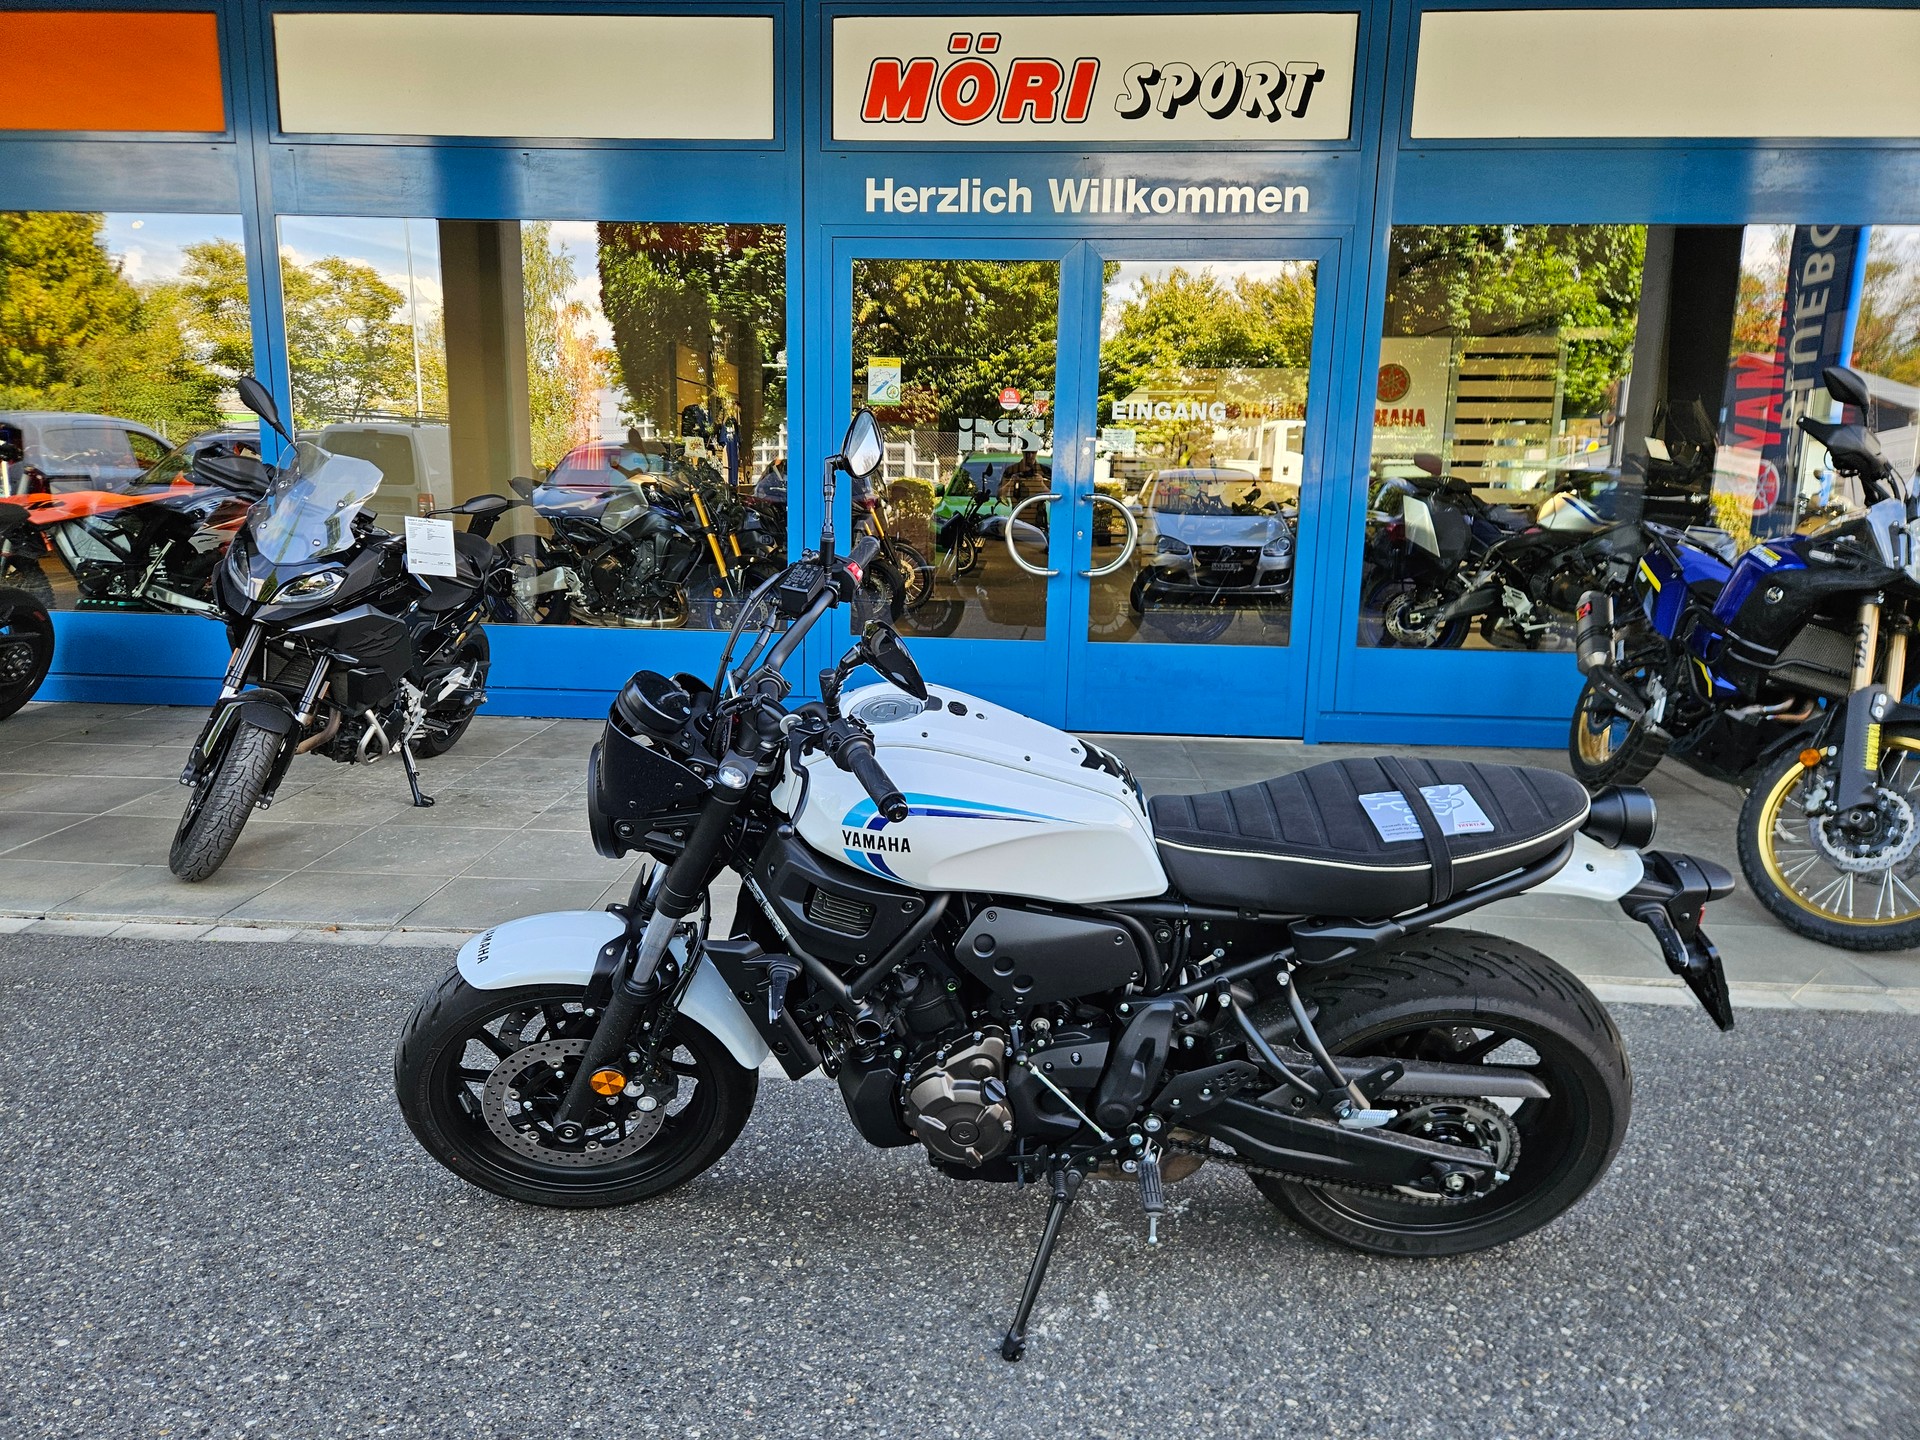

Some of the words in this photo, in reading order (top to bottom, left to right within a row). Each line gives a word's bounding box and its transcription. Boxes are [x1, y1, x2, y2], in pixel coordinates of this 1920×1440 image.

[861, 33, 1100, 125] MÖRI
[1114, 61, 1325, 123] SPORT
[865, 177, 1032, 213] Herzlich
[1048, 178, 1310, 214] Willkommen
[1111, 401, 1227, 421] EINGANG
[841, 830, 912, 853] YAMAHA
